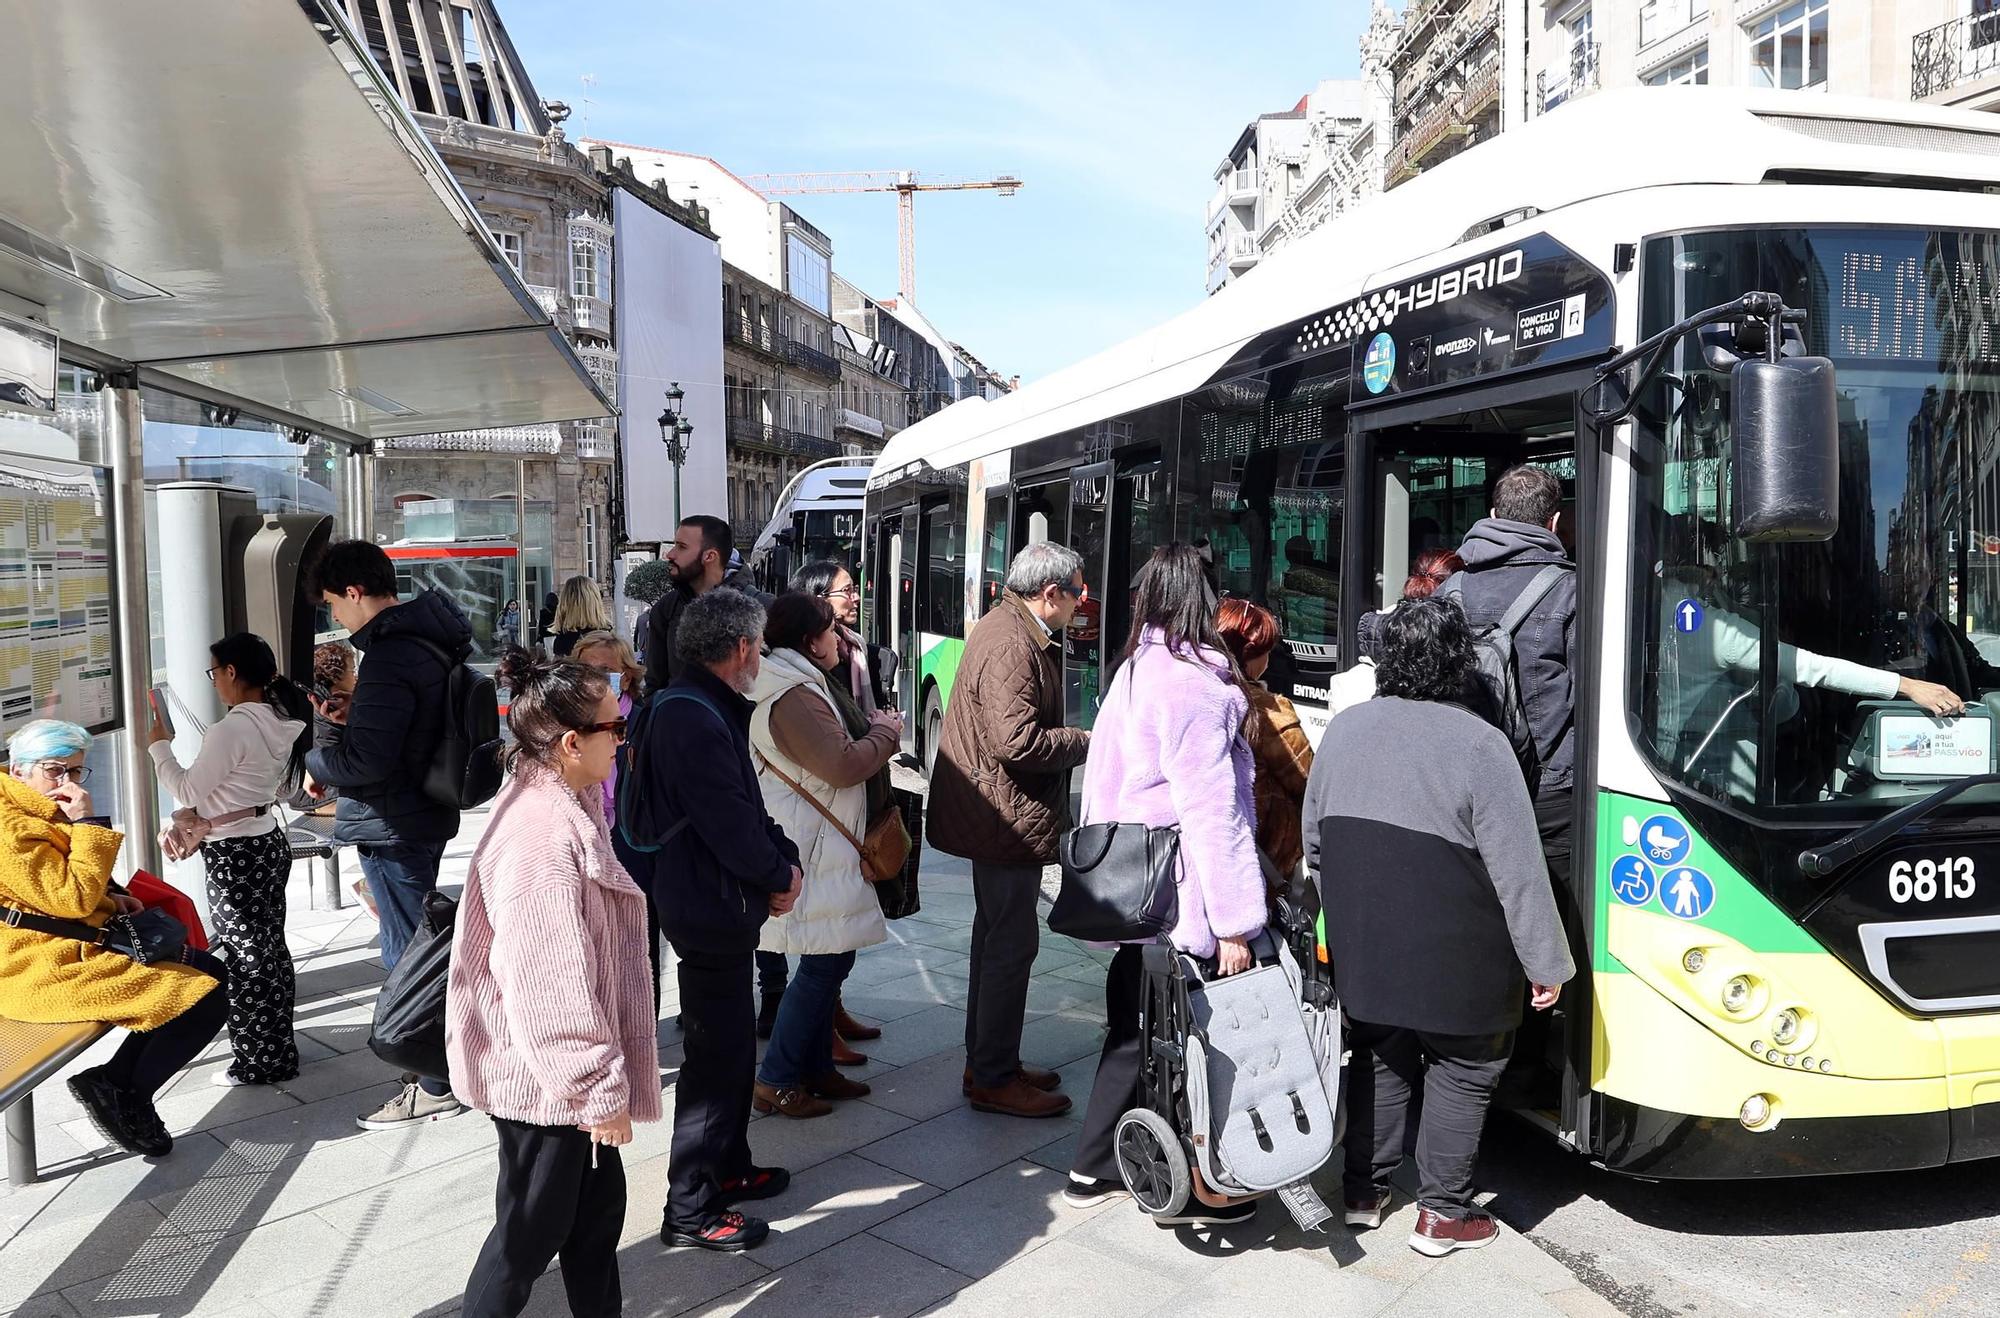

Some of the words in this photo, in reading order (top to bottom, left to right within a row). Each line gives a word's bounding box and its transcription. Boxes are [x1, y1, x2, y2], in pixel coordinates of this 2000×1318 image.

[1393, 249, 1525, 317] HYBRID
[1520, 309, 1560, 329] CONCELLO
[1523, 328, 1534, 340] DE
[1535, 323, 1555, 337] VIGO
[1435, 337, 1469, 356] avanza
[833, 514, 856, 537] C1
[1888, 856, 1976, 904] 6813
